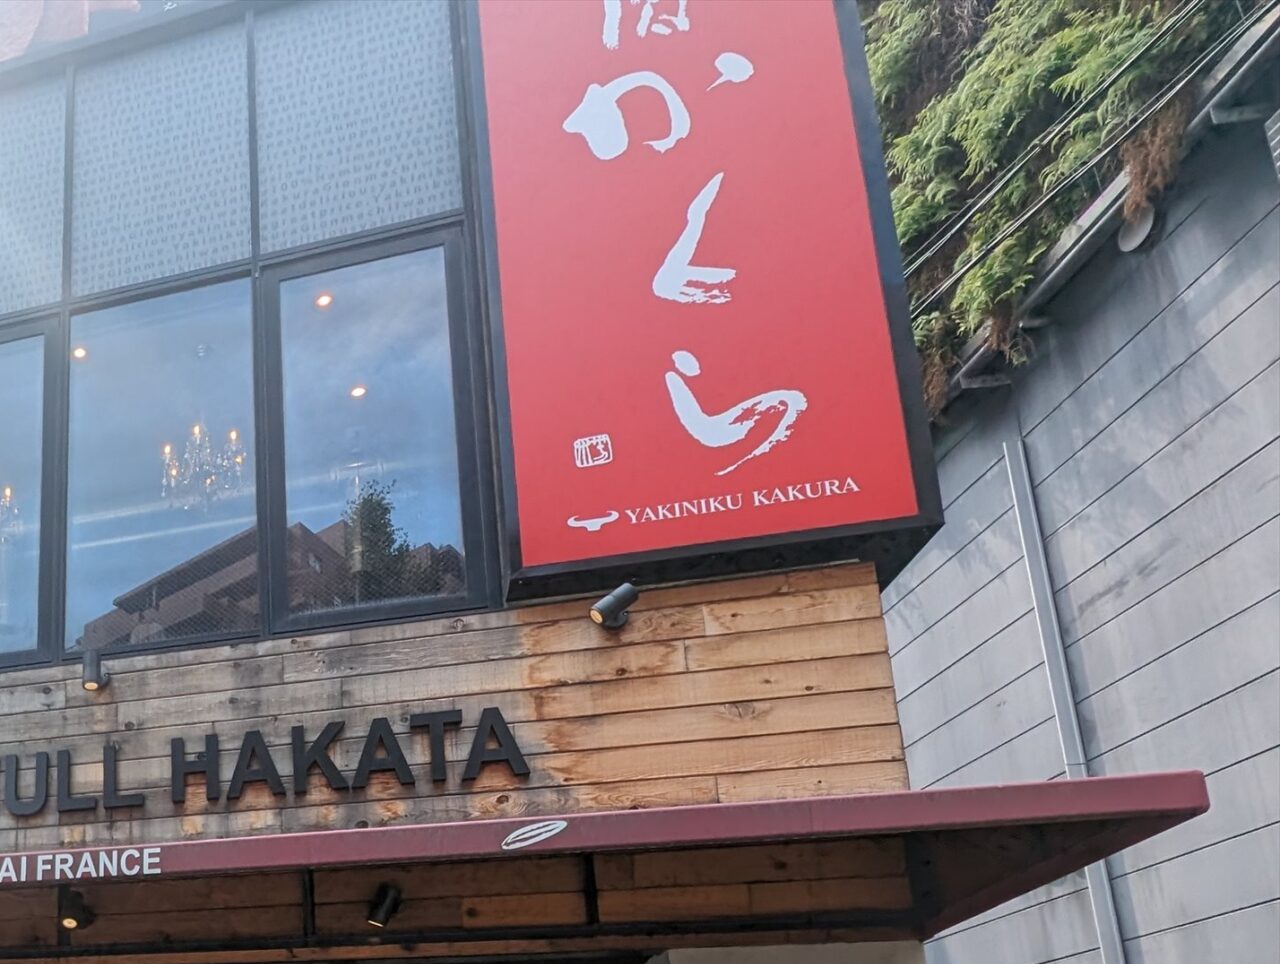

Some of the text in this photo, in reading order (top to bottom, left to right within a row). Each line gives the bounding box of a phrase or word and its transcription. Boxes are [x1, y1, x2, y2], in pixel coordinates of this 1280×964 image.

[562, 0, 809, 475] かくら
[625, 476, 861, 525] YAKINIKU KAKURA
[170, 706, 531, 804] HAKATA
[36, 847, 161, 881] FRANCE
